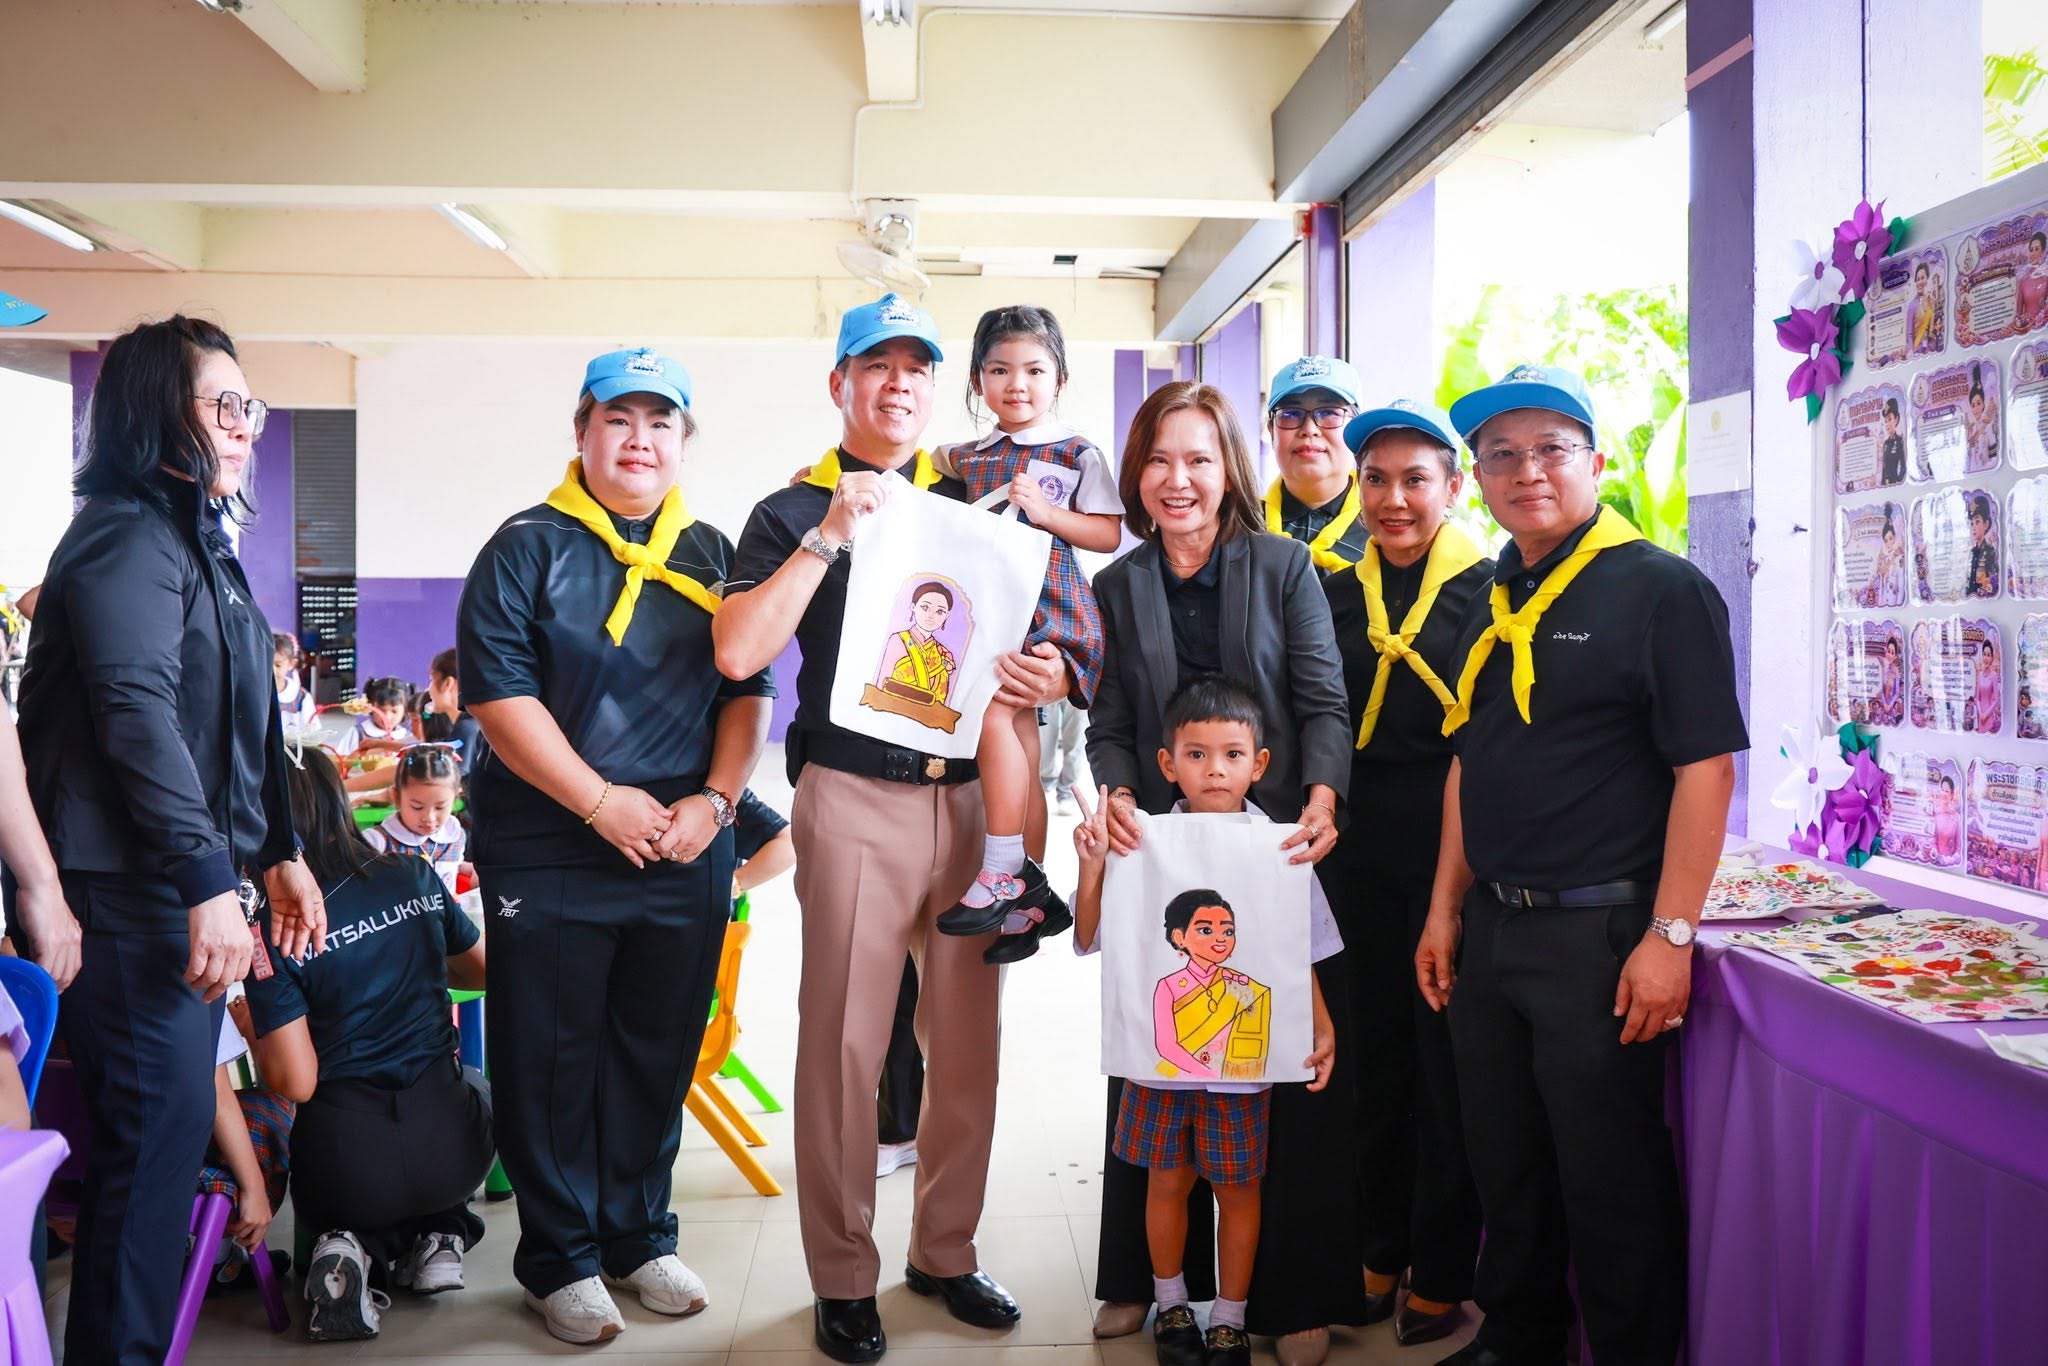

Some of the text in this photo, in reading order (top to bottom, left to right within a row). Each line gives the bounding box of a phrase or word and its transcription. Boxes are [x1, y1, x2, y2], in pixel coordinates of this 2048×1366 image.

[1931, 383, 1969, 402] ทางราชการ
[1986, 773, 2047, 791] พระราชกรณียกิจ
[498, 907, 520, 918] FBT
